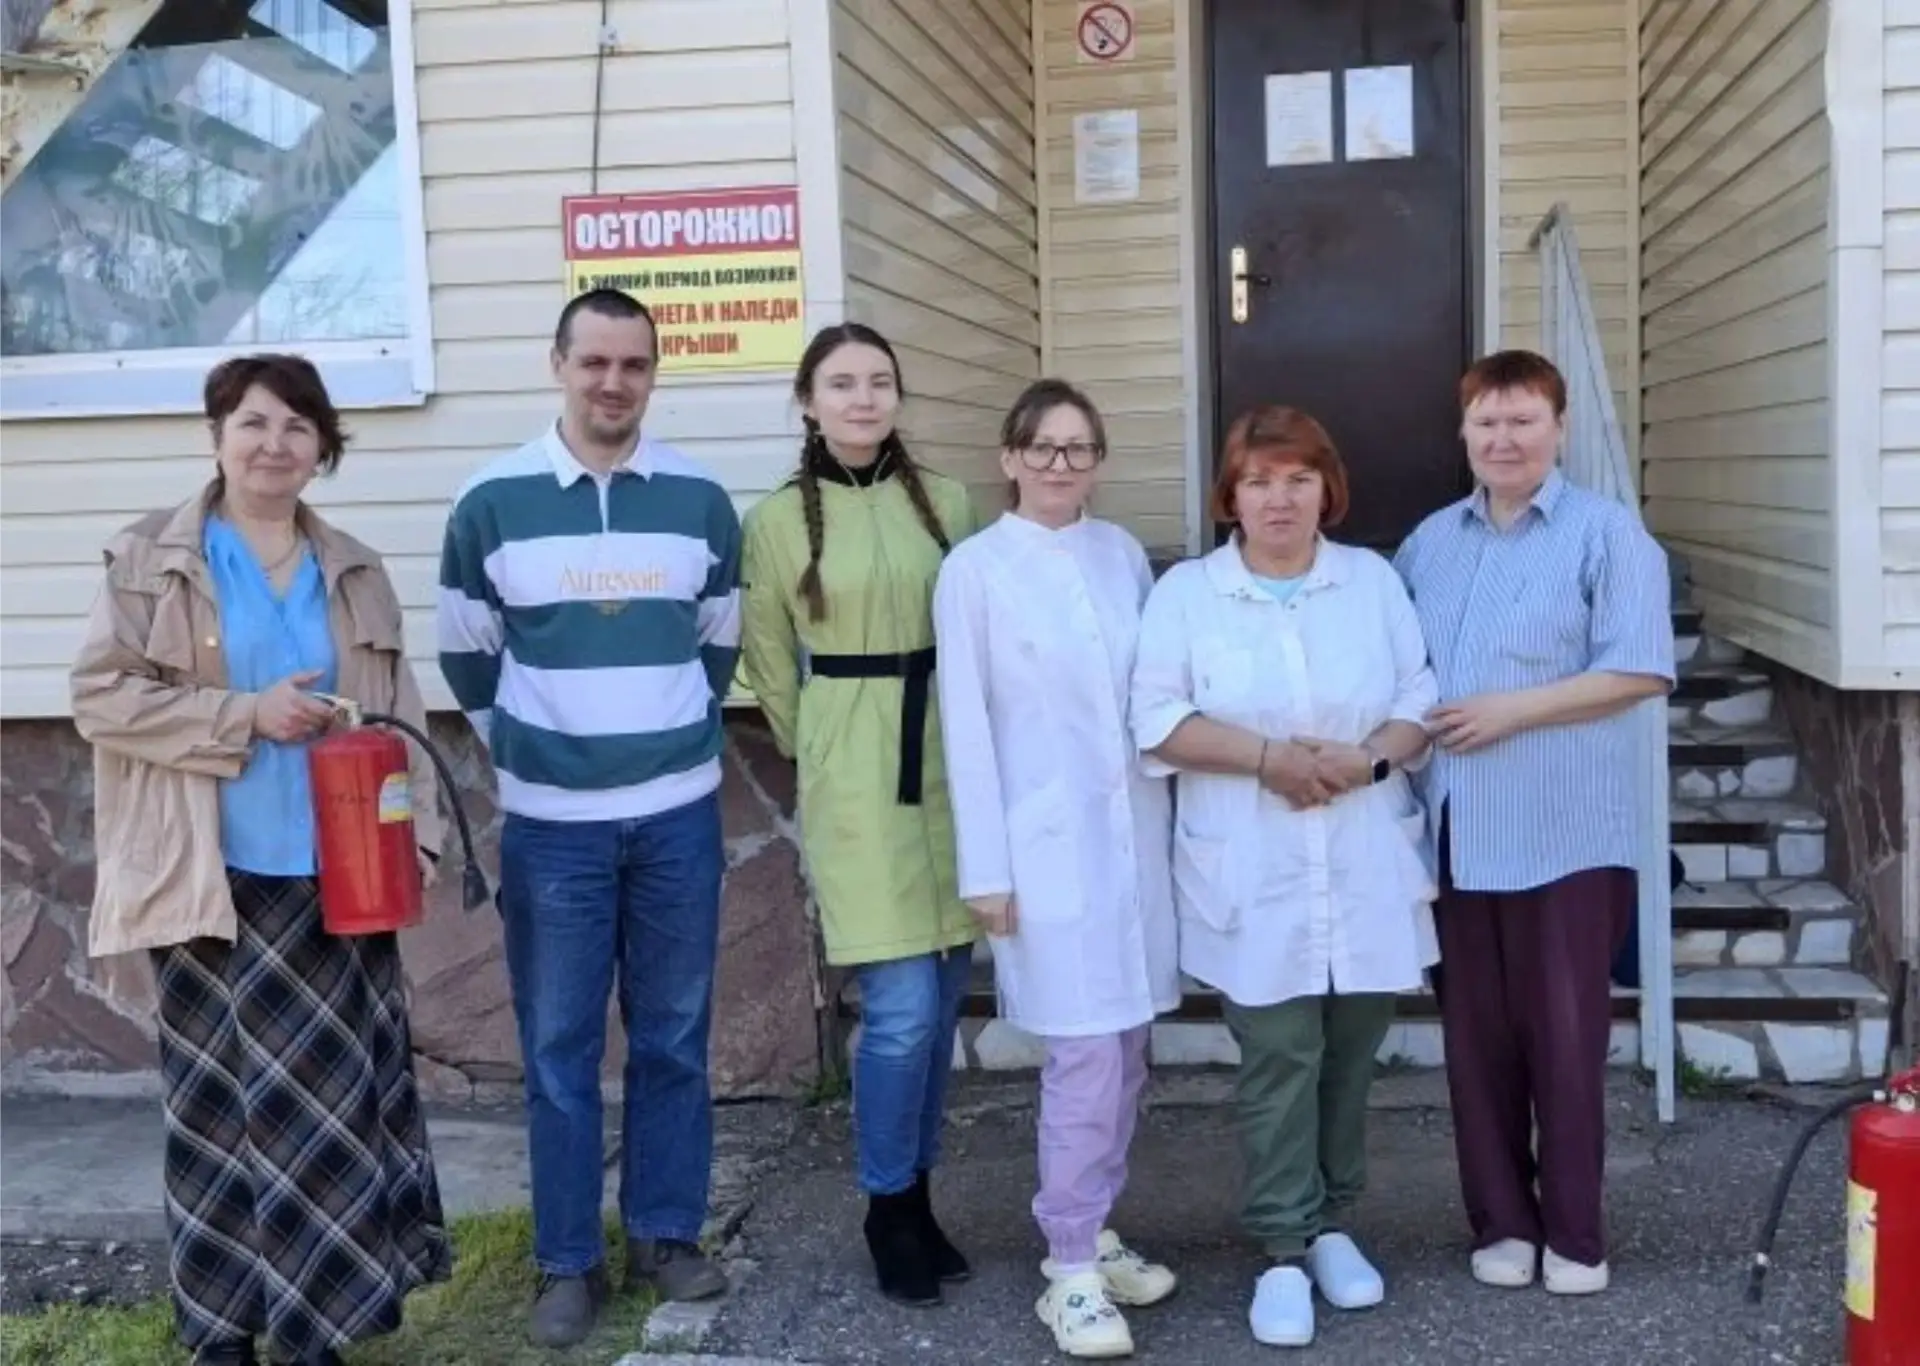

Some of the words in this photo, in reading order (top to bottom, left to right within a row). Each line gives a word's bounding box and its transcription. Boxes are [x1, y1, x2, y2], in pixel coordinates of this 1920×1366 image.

[575, 204, 796, 251] ОСТОРОЖНО!
[655, 269, 712, 288] ПЕРИОД
[715, 265, 797, 285] ВОЗМОЖЕН
[652, 302, 699, 325] НЕГА
[702, 301, 715, 322] И
[720, 298, 799, 325] НАЛЕДИ
[660, 332, 739, 356] КРЫШИ
